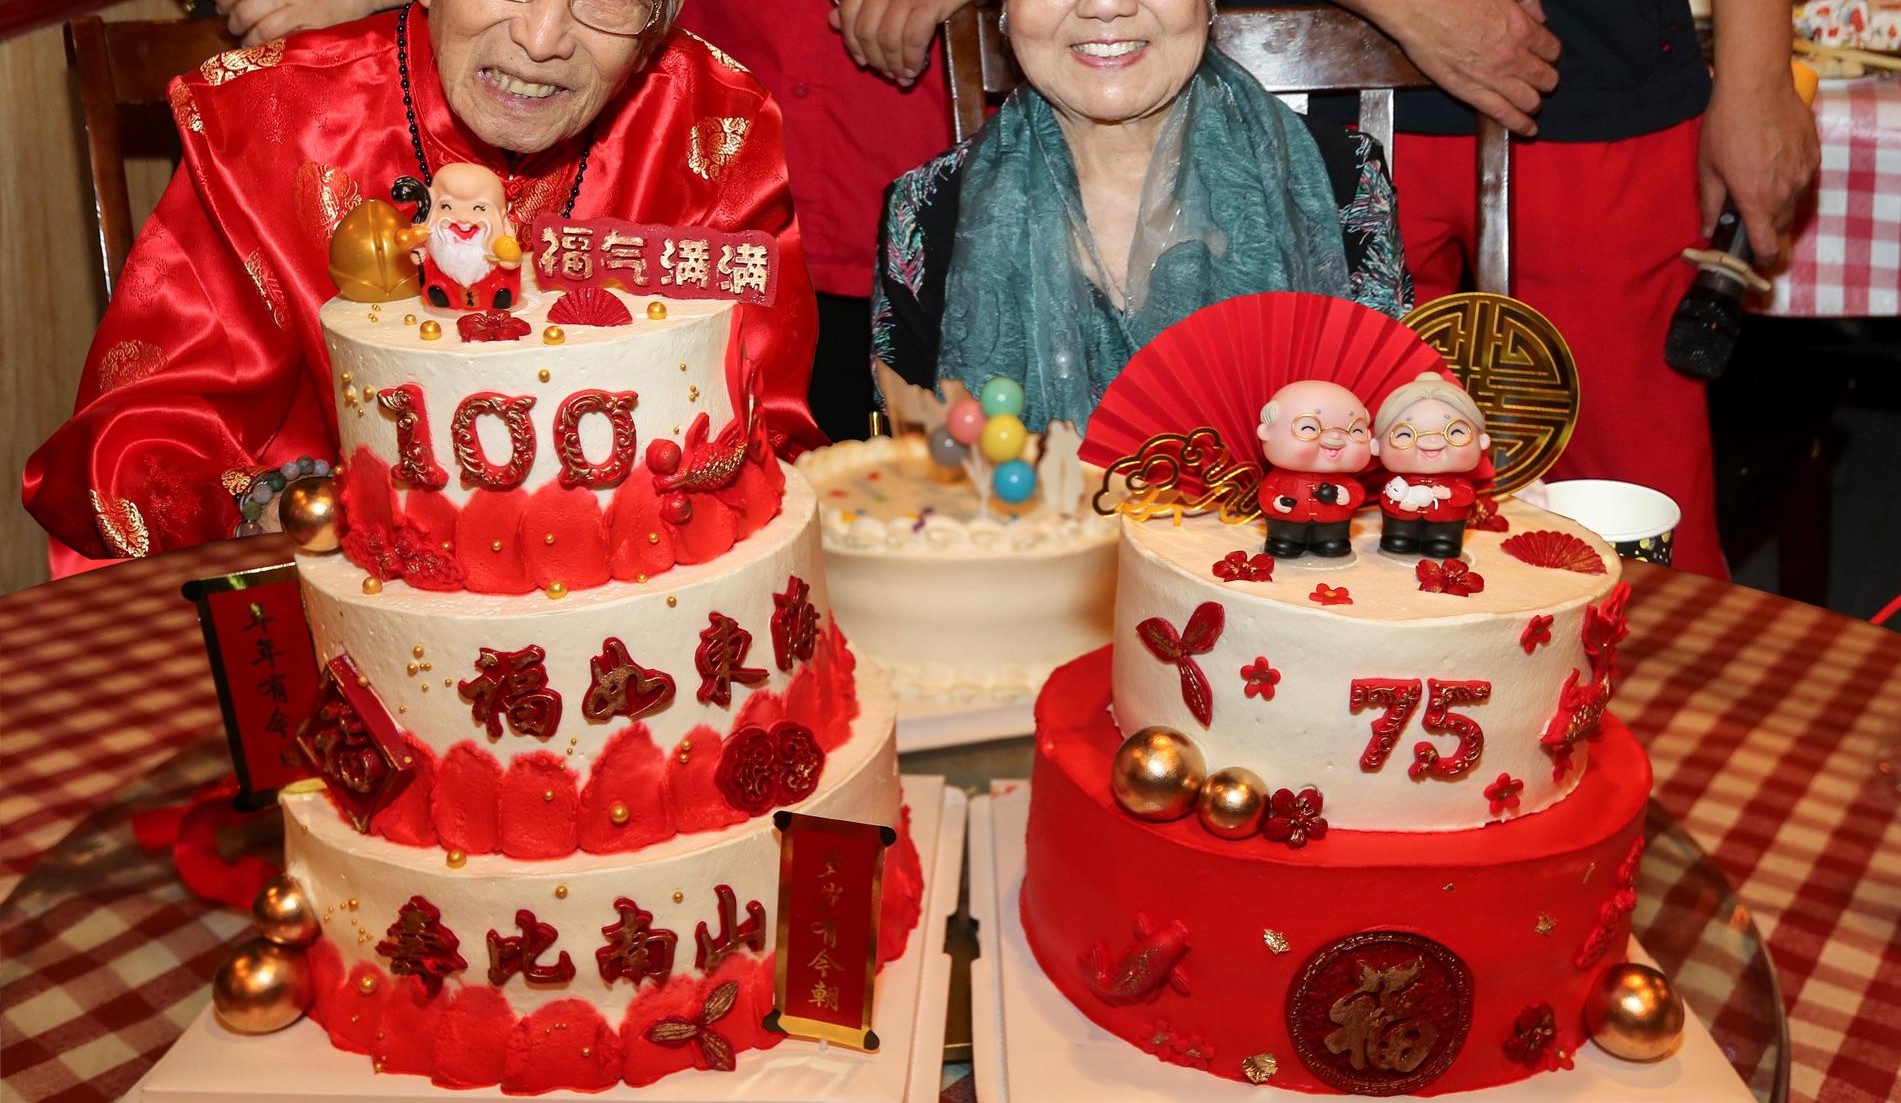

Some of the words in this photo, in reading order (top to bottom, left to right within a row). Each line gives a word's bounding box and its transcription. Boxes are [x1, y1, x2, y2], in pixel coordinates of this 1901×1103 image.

[538, 226, 770, 295] 福气满满
[376, 382, 639, 488] 100
[1349, 678, 1492, 782] 75
[1324, 955, 1438, 1073] 福
